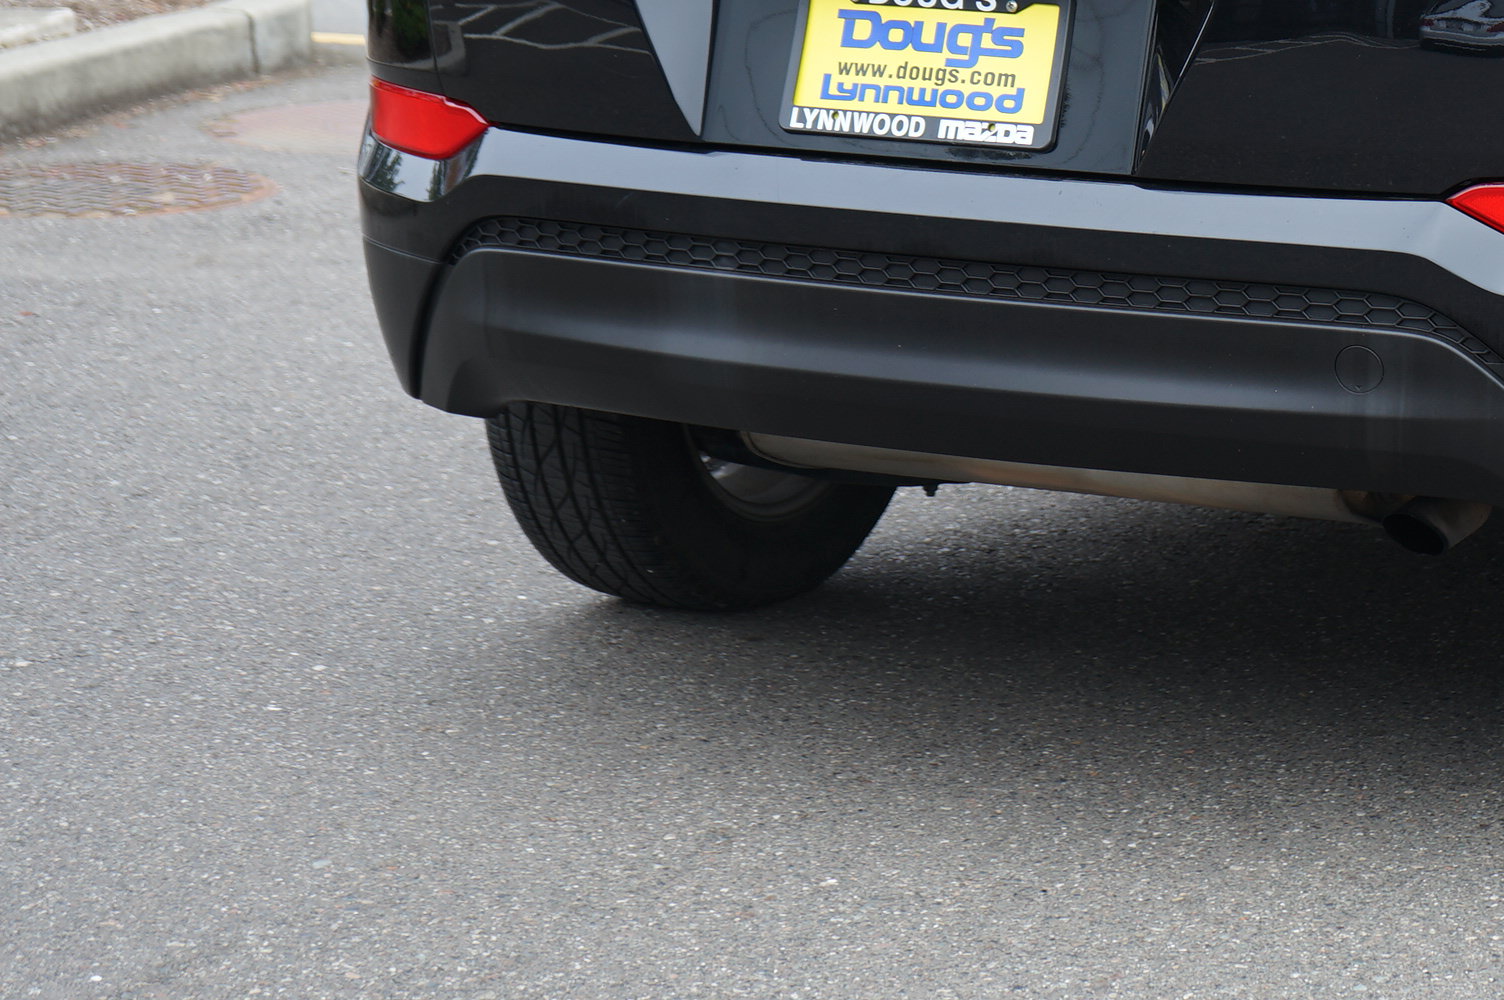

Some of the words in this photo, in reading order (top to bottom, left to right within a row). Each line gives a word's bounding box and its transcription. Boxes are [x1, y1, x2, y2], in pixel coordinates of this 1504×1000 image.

[837, 8, 1026, 69] Doug's
[837, 60, 1017, 88] www.dougs.com
[819, 73, 1026, 115] Lynnwood
[789, 106, 926, 138] LYNNWOOD
